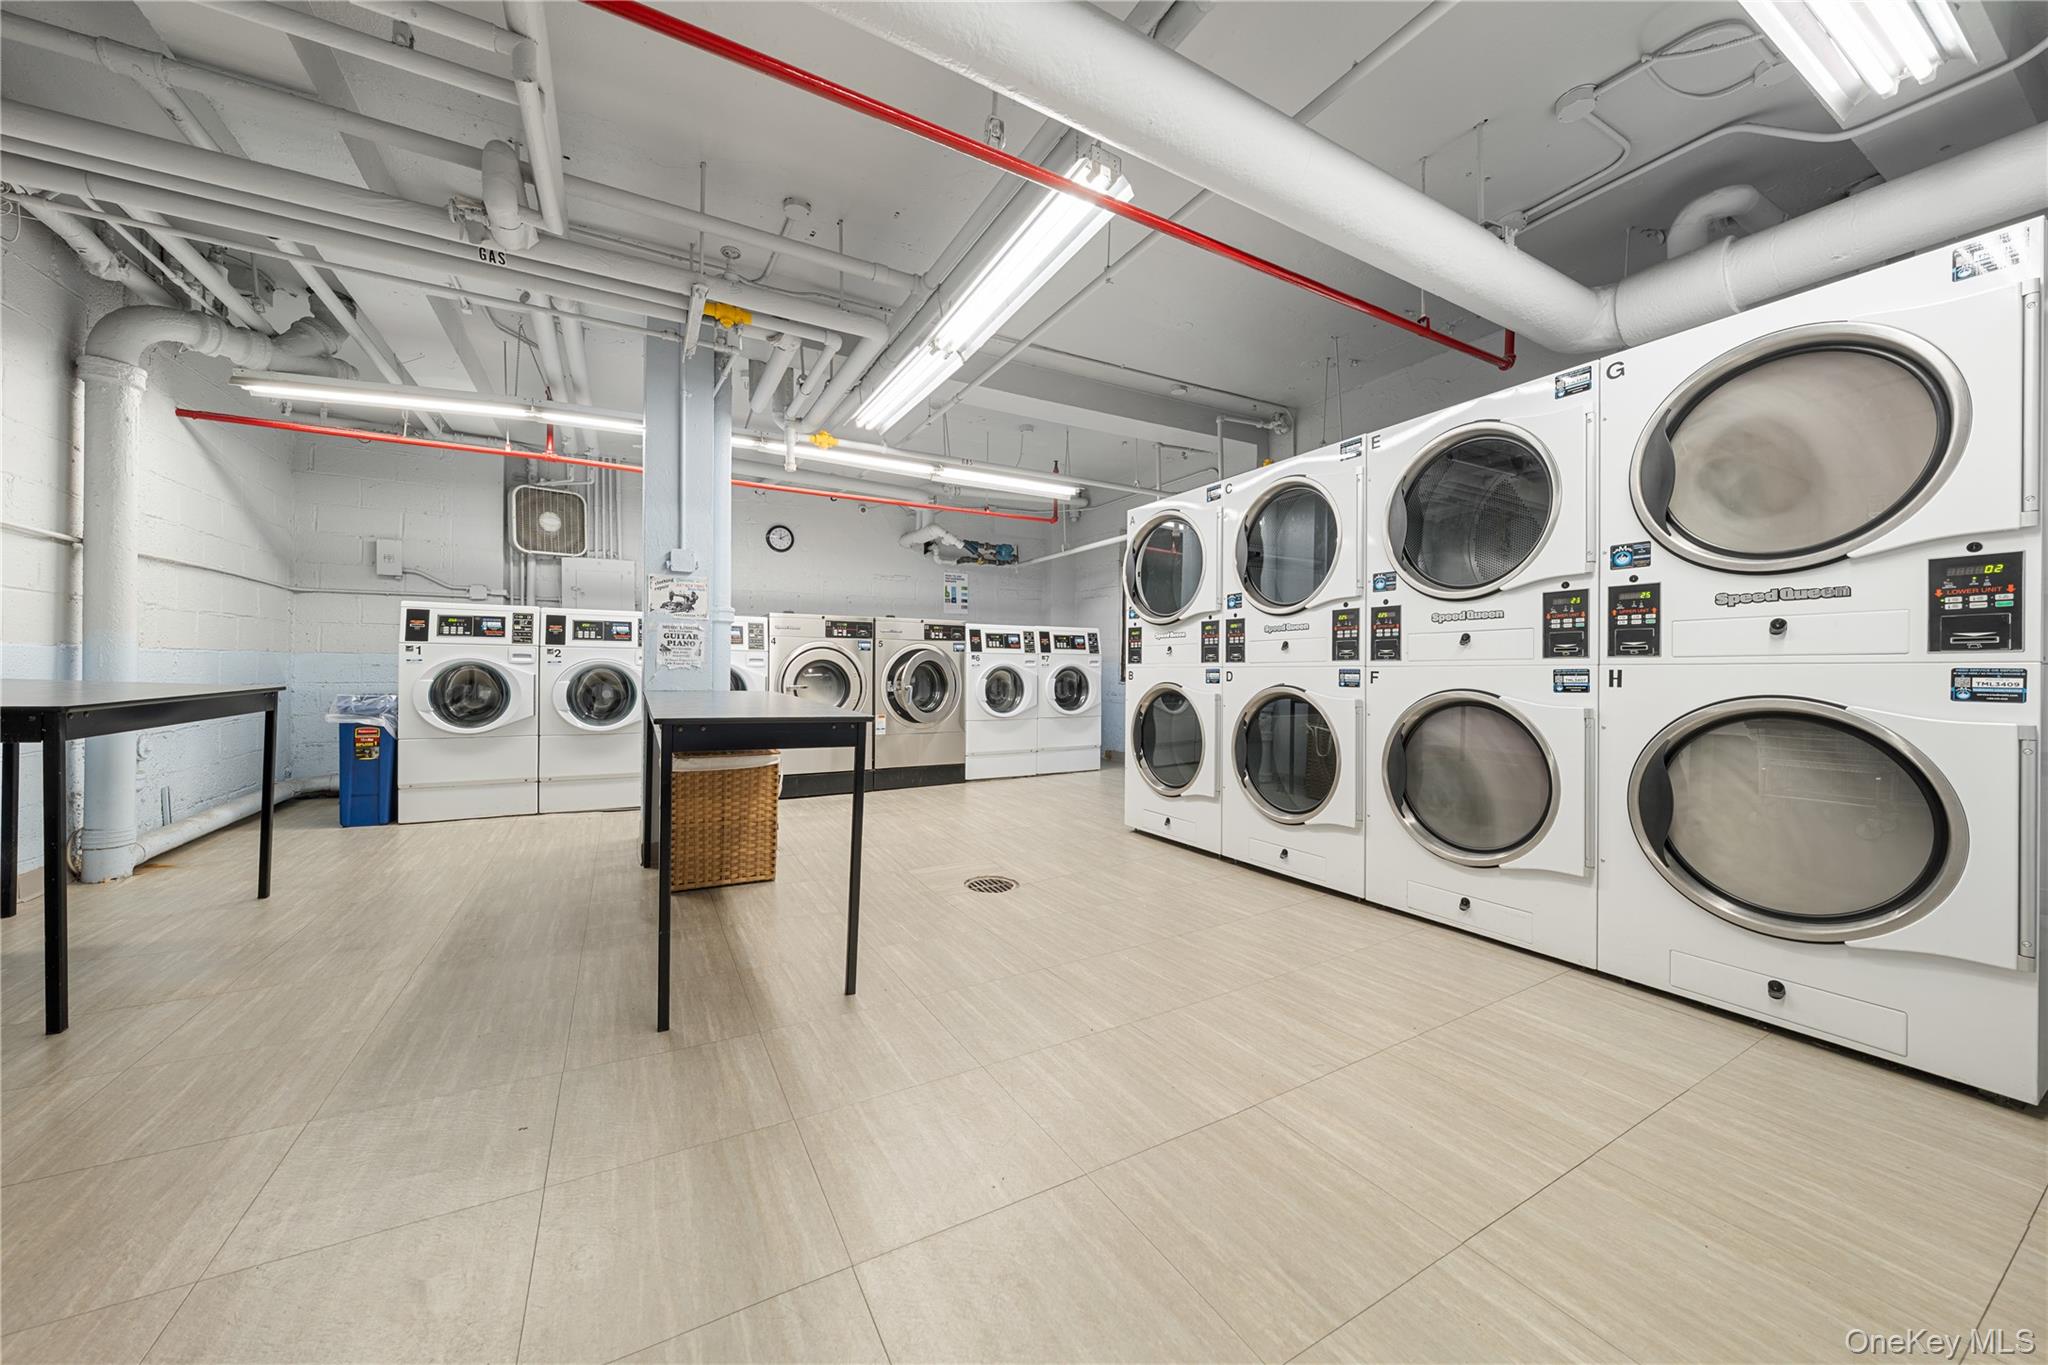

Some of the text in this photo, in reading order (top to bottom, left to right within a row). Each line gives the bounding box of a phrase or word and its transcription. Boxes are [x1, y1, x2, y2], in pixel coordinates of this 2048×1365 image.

[478, 247, 506, 265] GAS
[1606, 361, 1625, 380] G
[1371, 434, 1381, 450] E
[1225, 483, 1233, 494] C
[1129, 516, 1136, 526] A
[1983, 564, 2005, 574] 02
[1946, 585, 2003, 595] LOWER UNIT
[1714, 586, 1852, 608] Speed Queen
[1431, 609, 1505, 624] Speed Queen
[1264, 622, 1310, 635] Speed Queen
[663, 632, 699, 640] GUITAR
[771, 637, 776, 645] 4
[666, 639, 696, 647] PIANO
[878, 640, 884, 648] 5
[415, 645, 422, 656] 1
[554, 648, 562, 658] 2
[975, 654, 981, 662] 6
[1128, 671, 1134, 681] B
[1226, 671, 1233, 682] D
[1370, 671, 1380, 684] F
[1608, 669, 1623, 688] H
